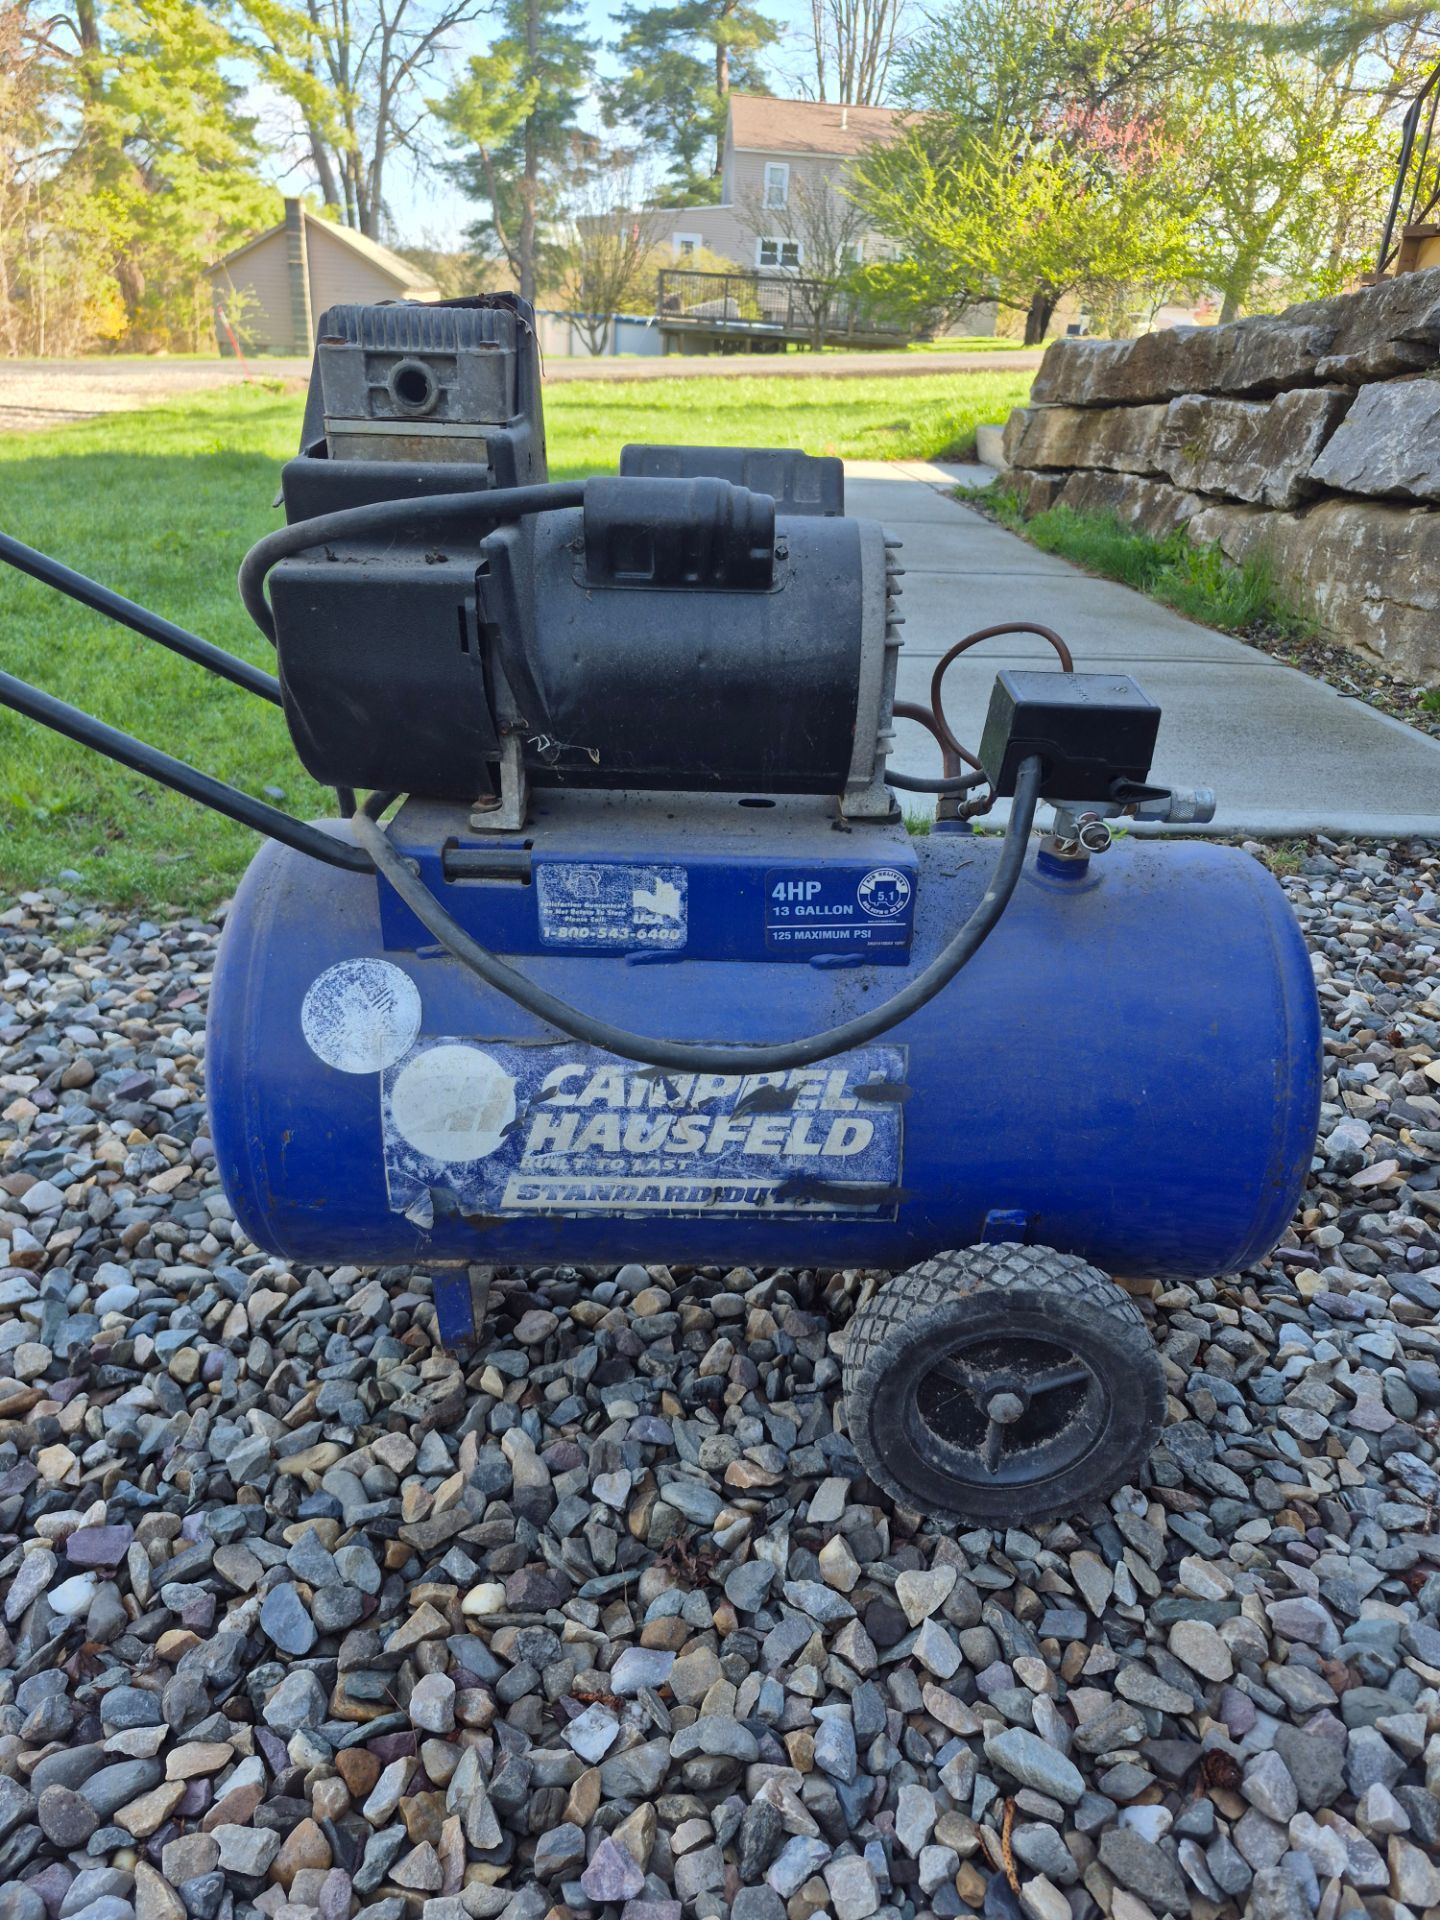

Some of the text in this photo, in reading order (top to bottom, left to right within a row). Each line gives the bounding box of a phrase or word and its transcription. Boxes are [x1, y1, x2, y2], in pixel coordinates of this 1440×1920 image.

[771, 881, 822, 902] 4HP
[877, 891, 894, 901] 5.1
[772, 905, 854, 916] 13 GALLON
[772, 929, 871, 941] 125 MAXIMUM PSI
[525, 1113, 875, 1157] HAUSFELD
[520, 1157, 692, 1171] BUILT TO LAST
[516, 1184, 712, 1203] STANDARD
